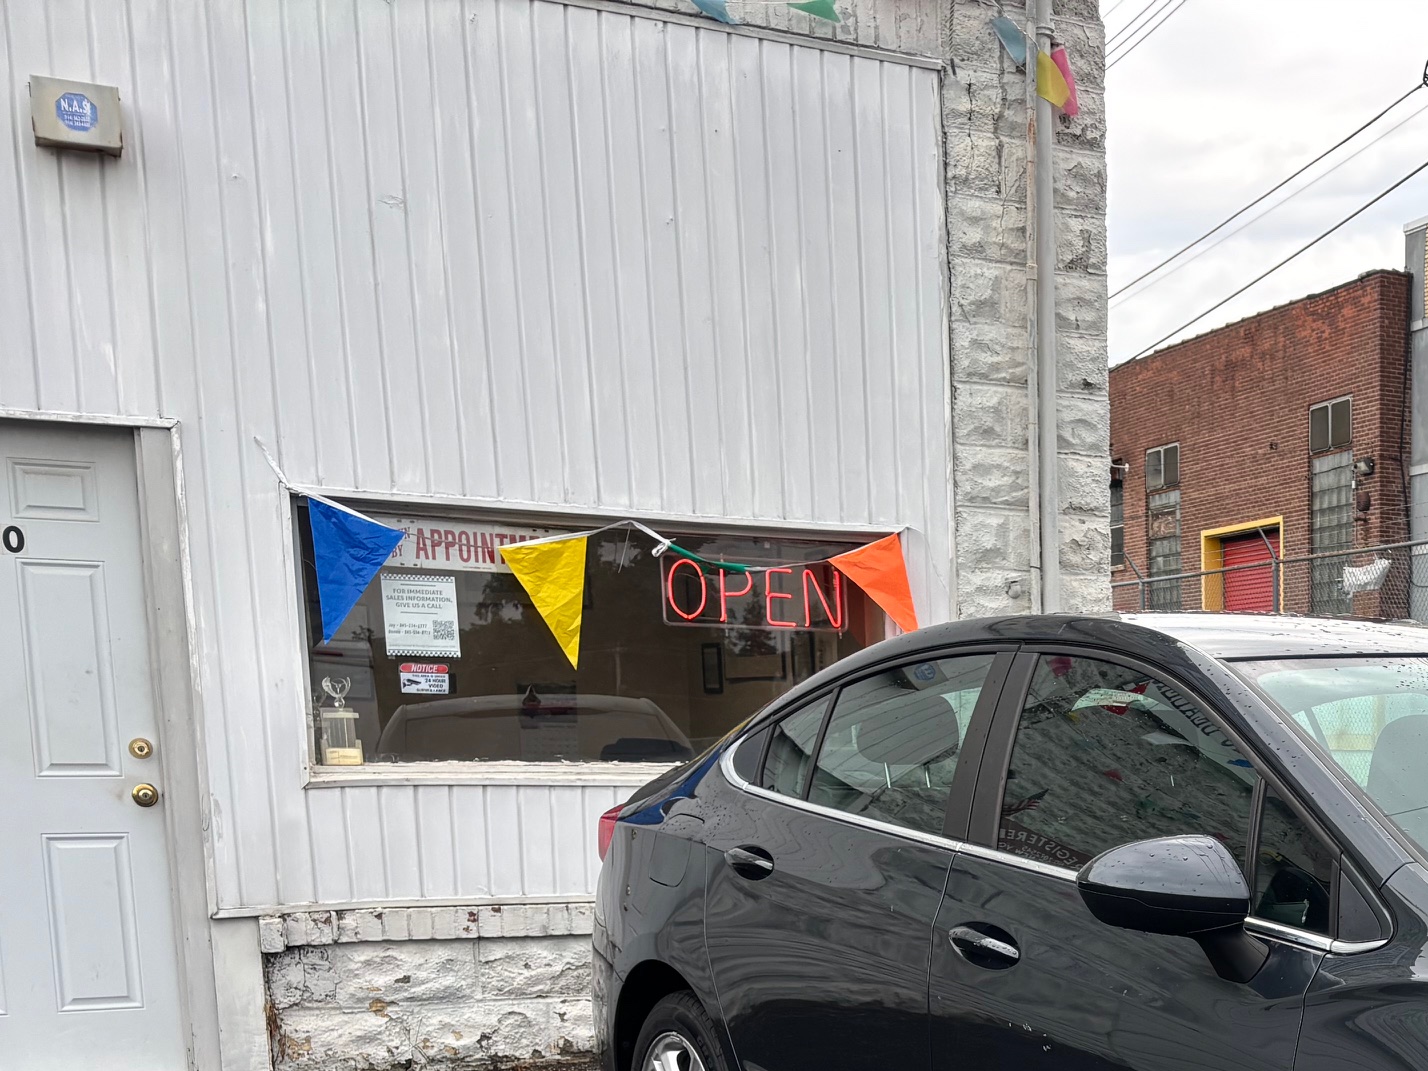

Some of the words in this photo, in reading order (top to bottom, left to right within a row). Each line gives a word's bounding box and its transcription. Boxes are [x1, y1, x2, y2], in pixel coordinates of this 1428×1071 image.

[2, 525, 25, 553] 0
[415, 527, 541, 565] APPOINT
[391, 544, 404, 558] BY
[405, 595, 453, 603] INFORMATION,
[407, 588, 443, 596] IMMEDIATE
[668, 559, 842, 629] OPEN
[411, 664, 438, 673] NOTICE
